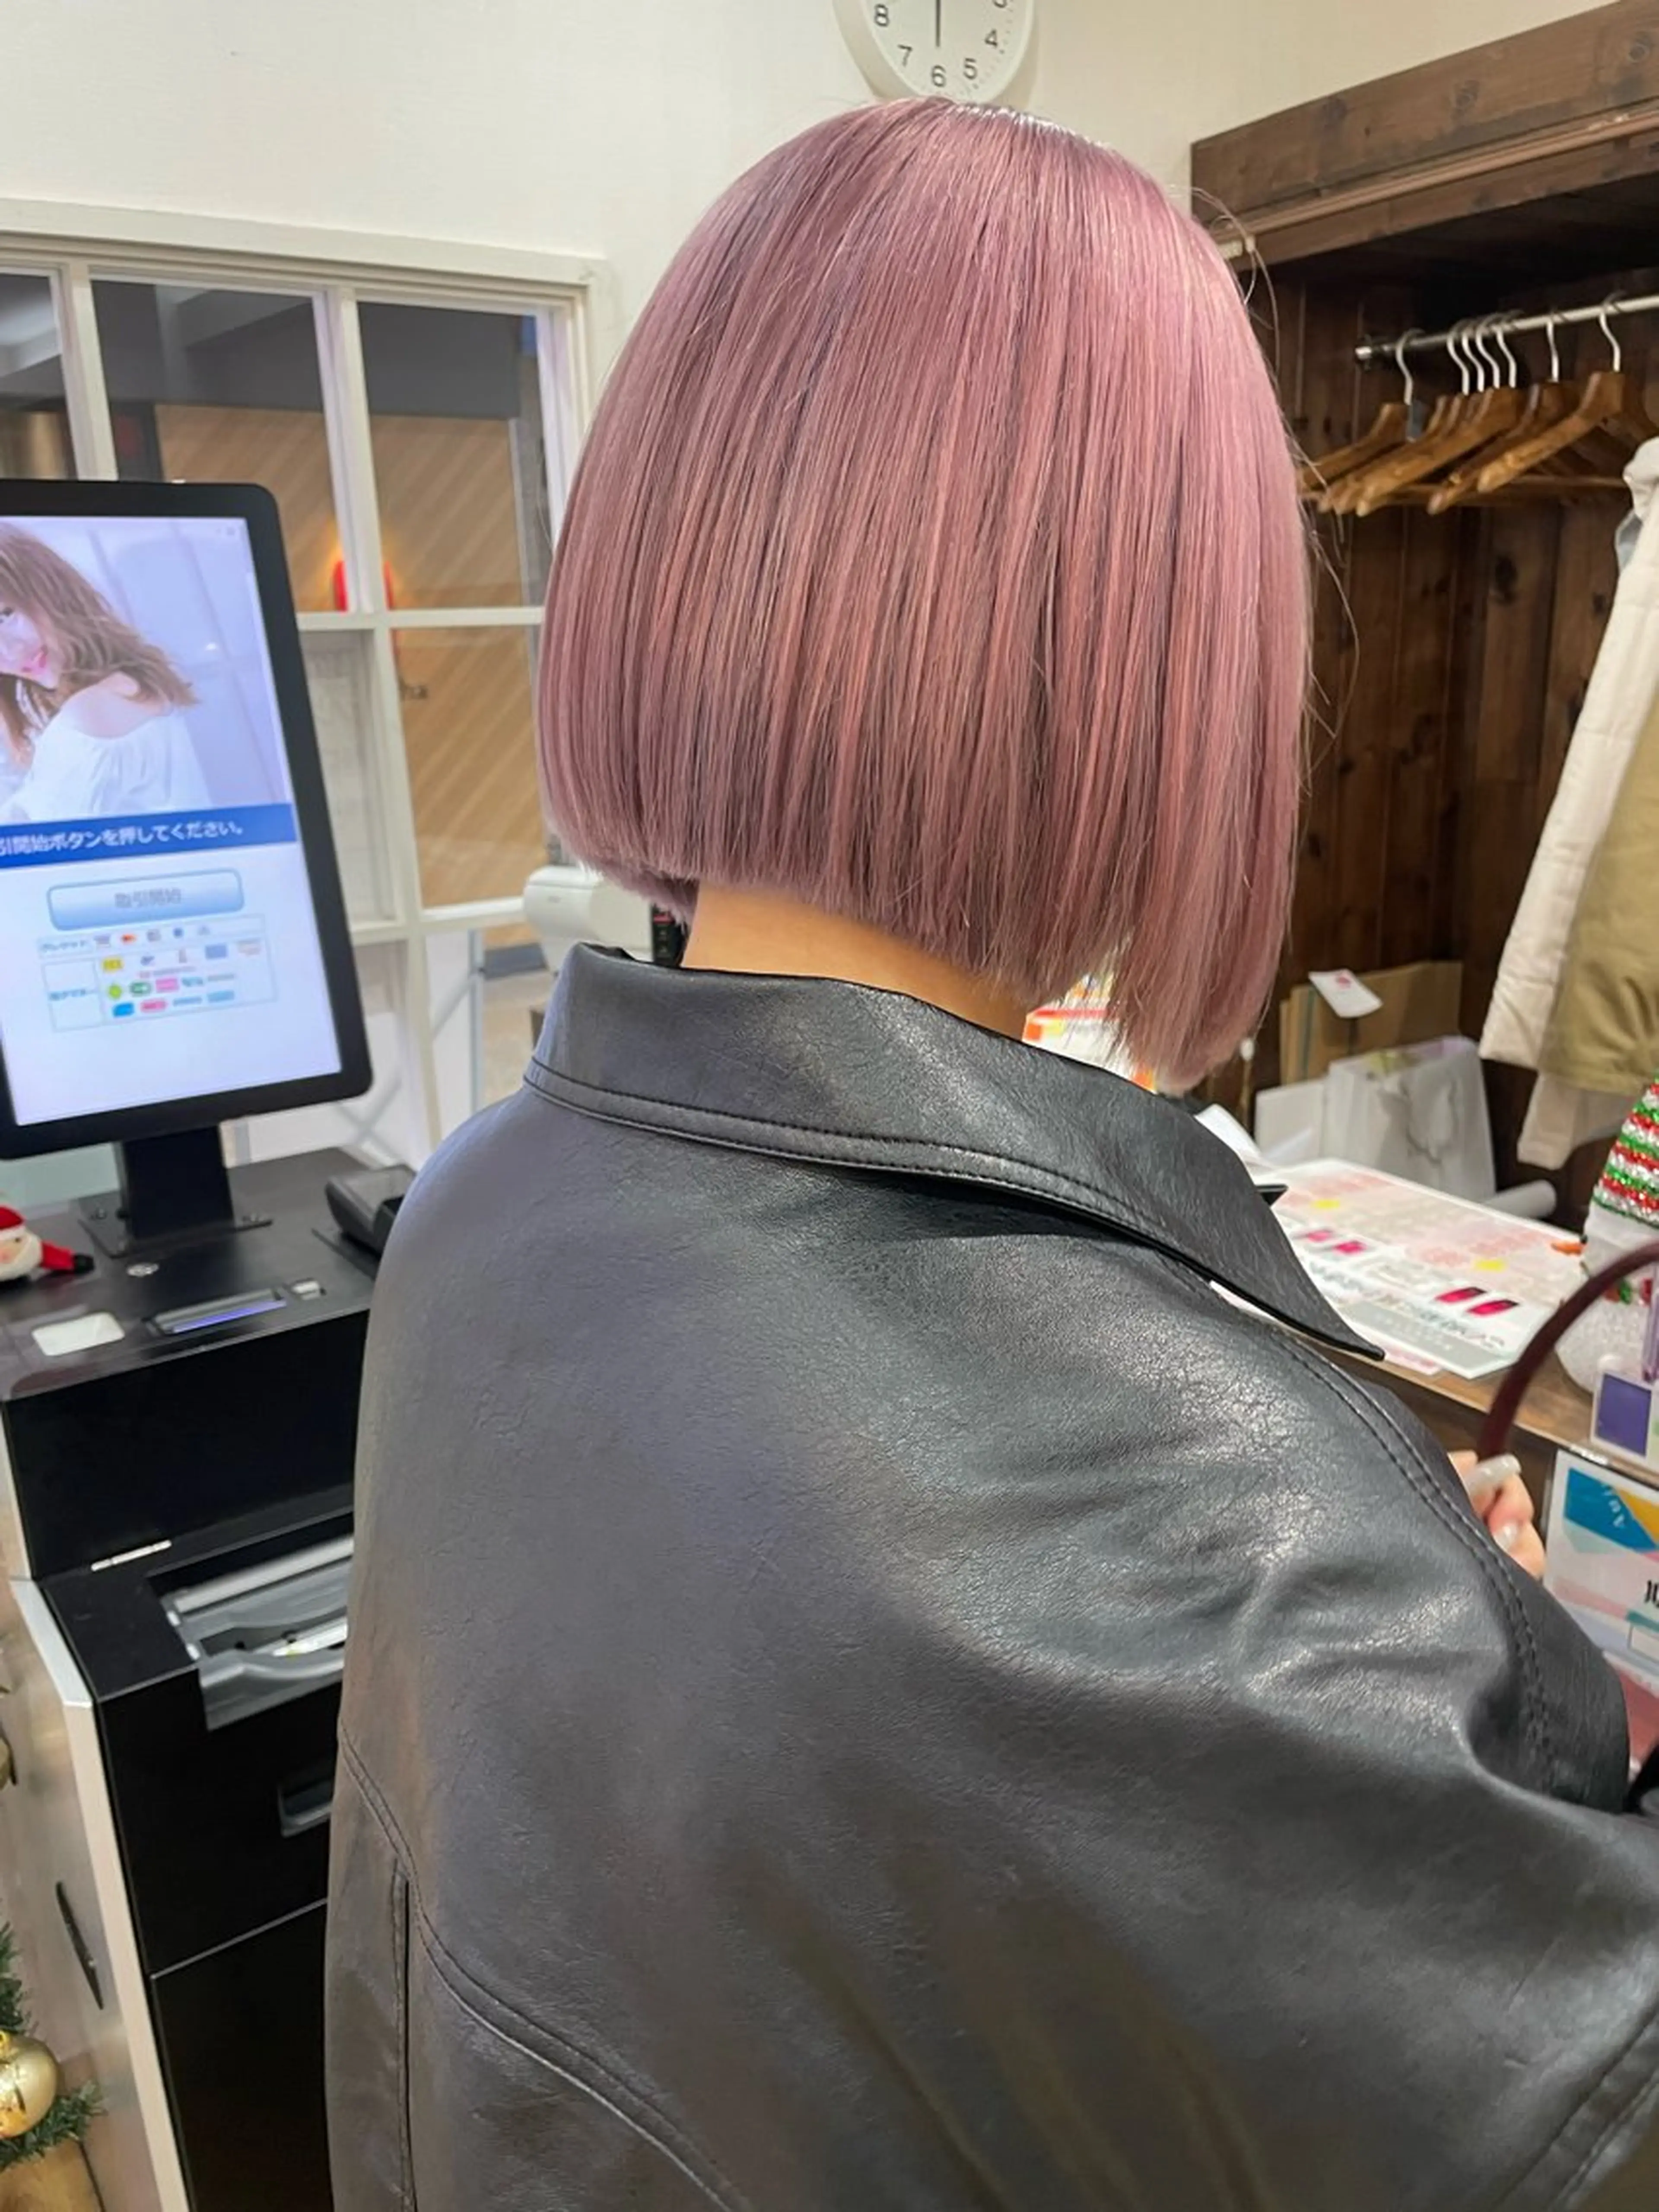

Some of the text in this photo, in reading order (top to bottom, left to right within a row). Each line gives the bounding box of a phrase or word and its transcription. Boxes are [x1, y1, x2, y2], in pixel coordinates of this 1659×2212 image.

[874, 4, 889, 27] 8
[984, 29, 998, 48] 4
[897, 44, 912, 66] 7
[931, 65, 946, 87] 6
[963, 57, 977, 79] 5
